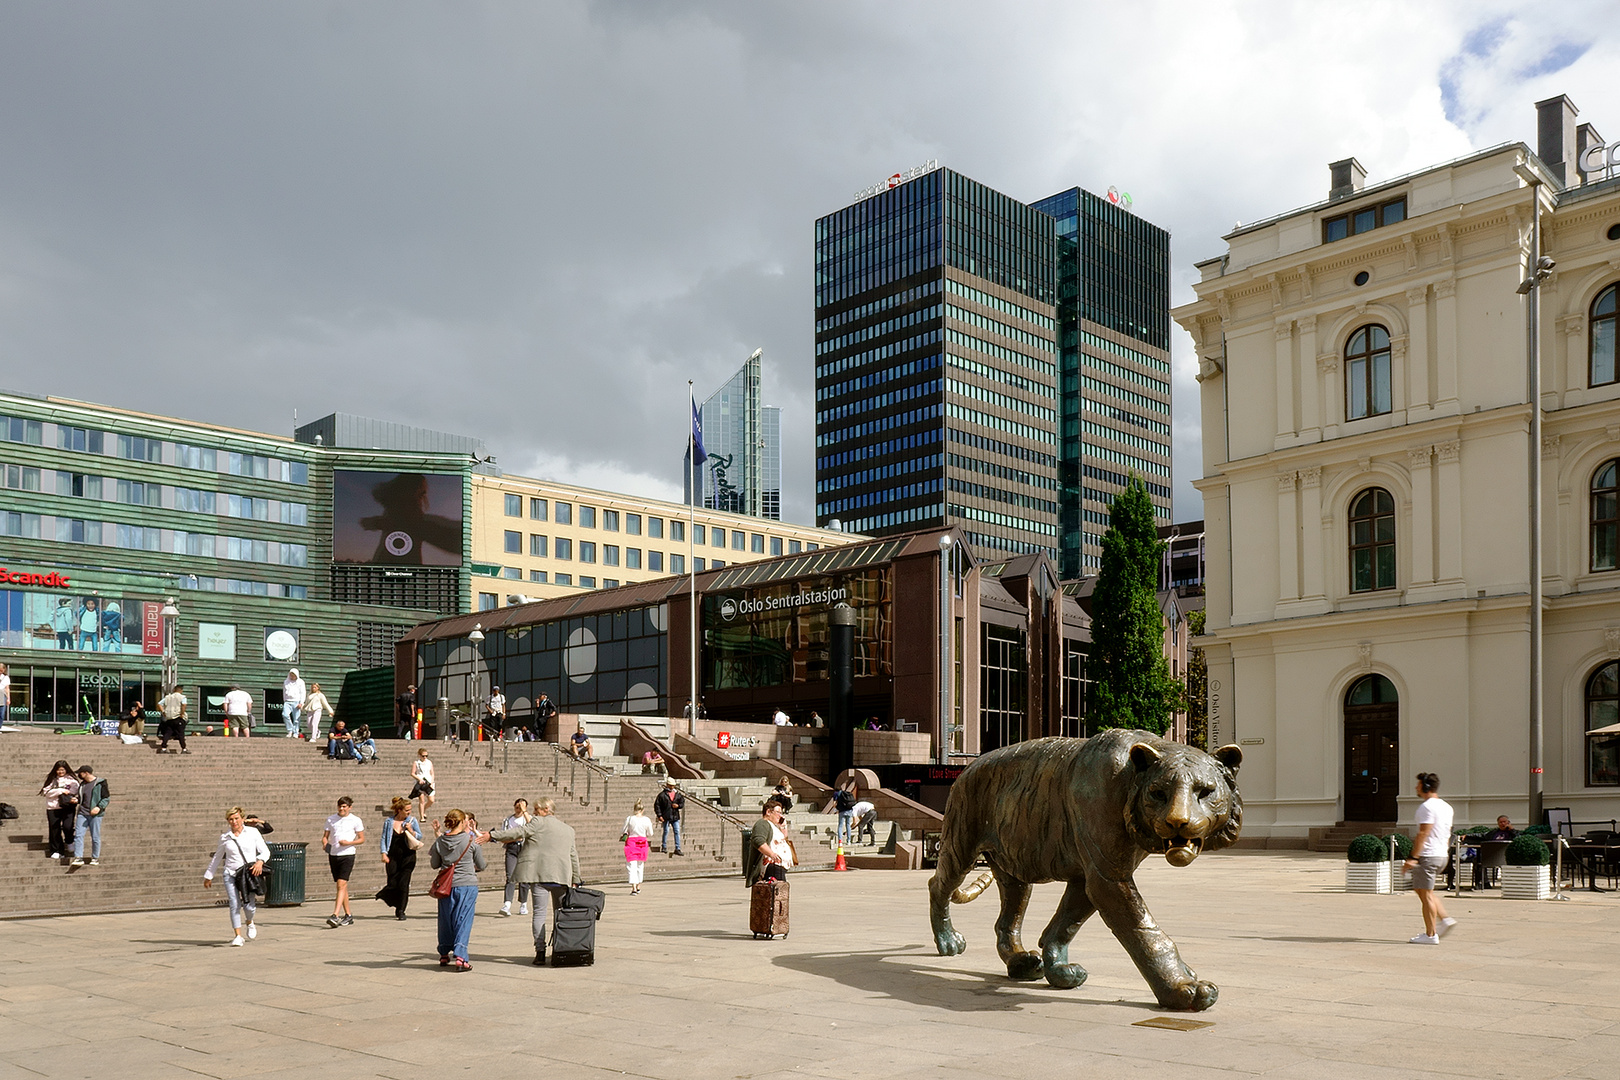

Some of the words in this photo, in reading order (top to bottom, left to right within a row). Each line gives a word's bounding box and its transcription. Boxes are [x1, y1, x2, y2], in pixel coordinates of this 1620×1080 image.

[902, 158, 938, 181] steria
[0, 567, 71, 587] Scandic
[739, 598, 763, 614] Oslo
[765, 586, 847, 610] Sentralstasjon
[147, 604, 159, 638] name
[81, 674, 120, 685] EGON
[1212, 694, 1220, 714] Oslo
[1212, 715, 1220, 745] Visitor
